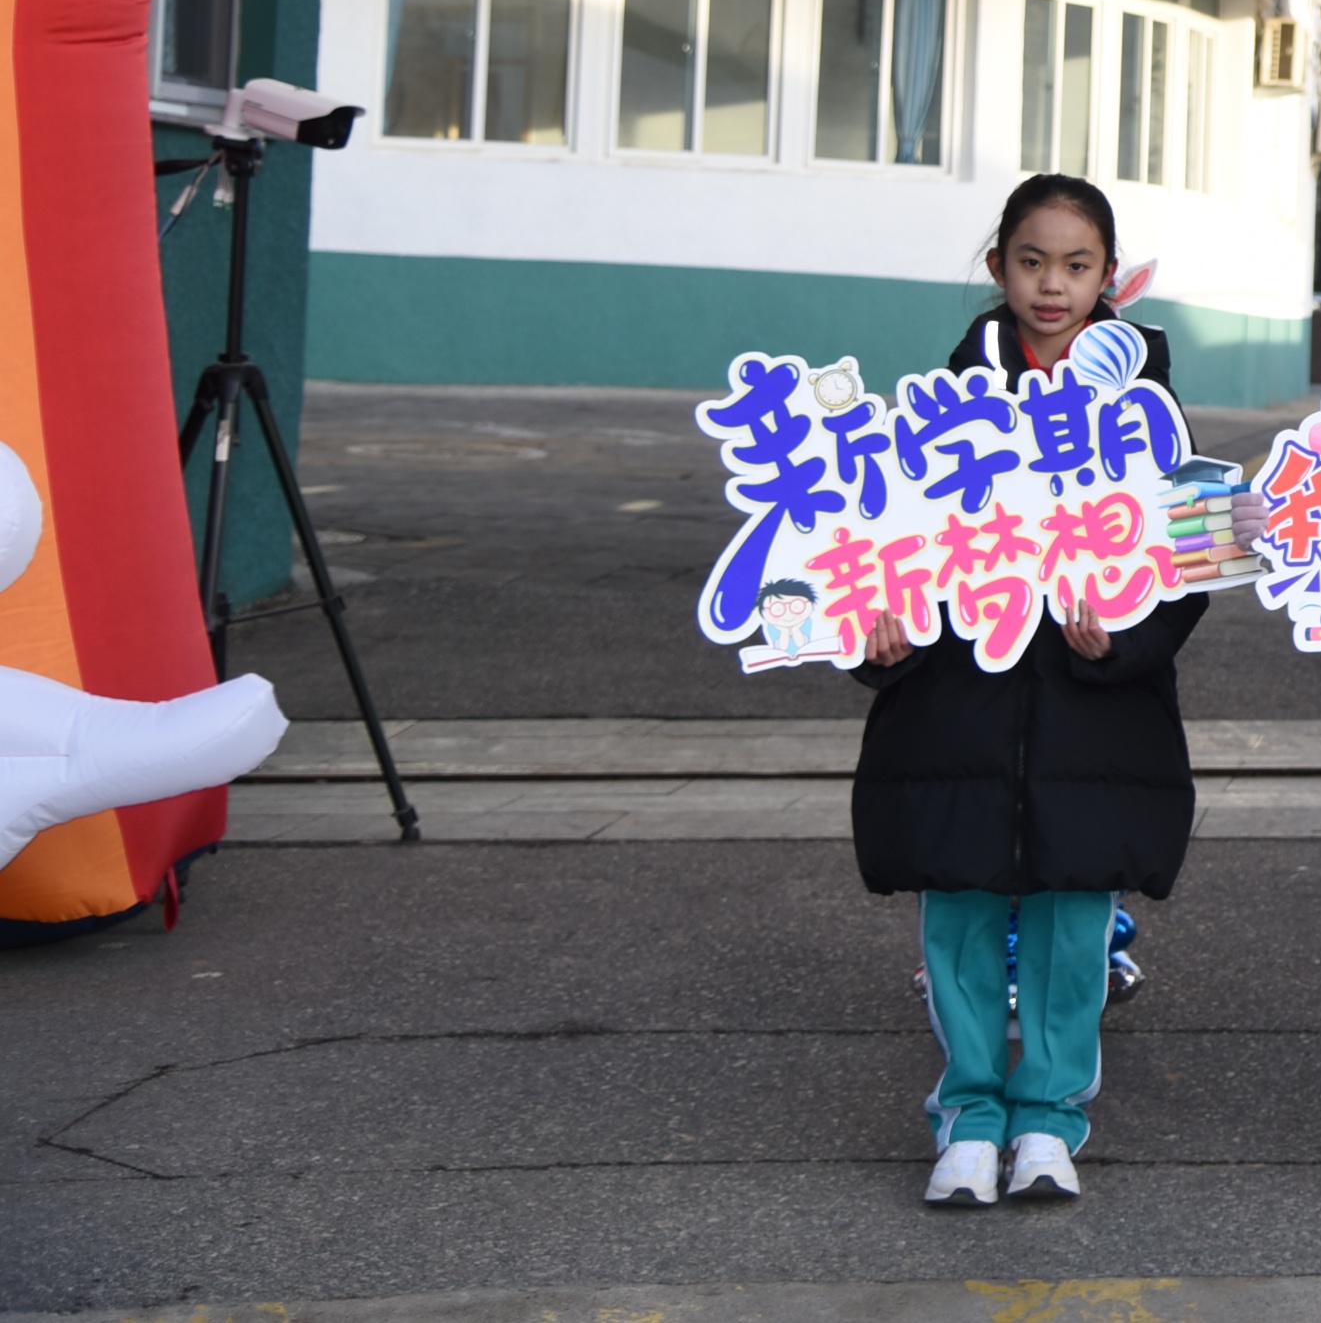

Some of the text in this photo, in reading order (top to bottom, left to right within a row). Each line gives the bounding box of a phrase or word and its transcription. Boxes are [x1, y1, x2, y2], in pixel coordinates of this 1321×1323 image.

[707, 359, 1181, 631] 新学期
[806, 493, 1184, 660] 新梦想
